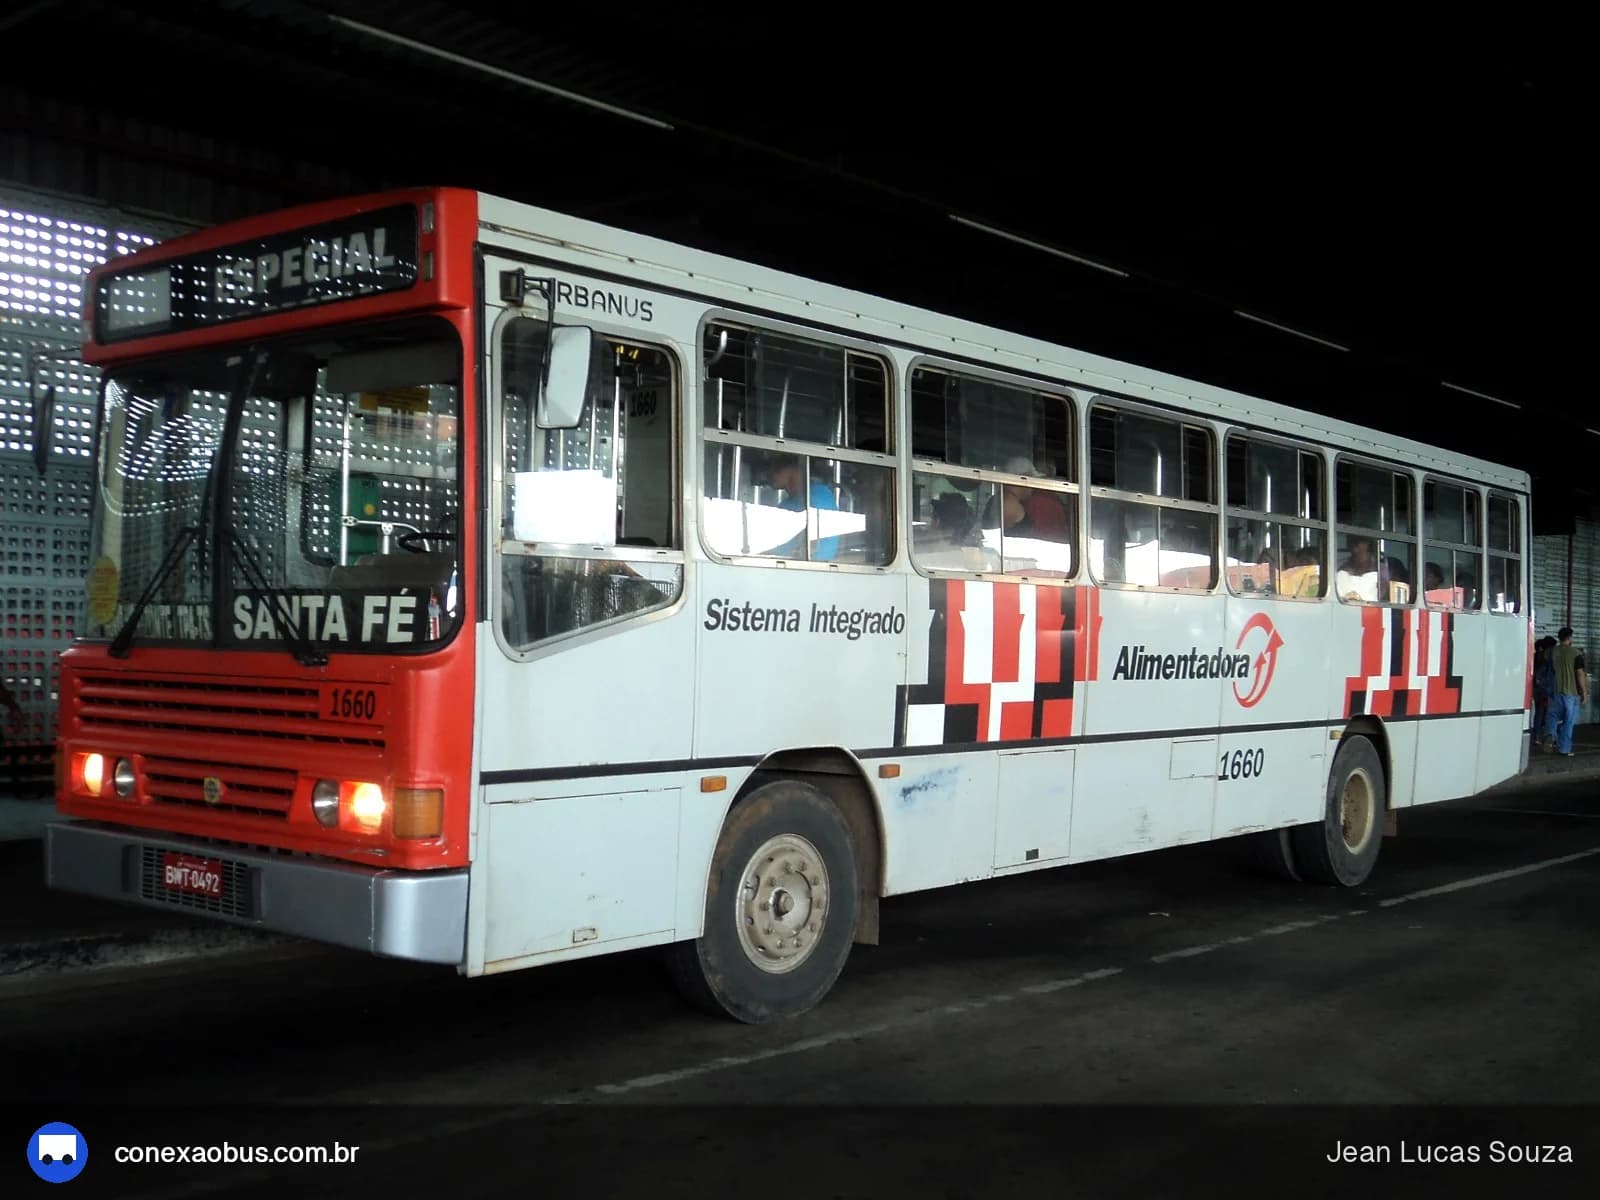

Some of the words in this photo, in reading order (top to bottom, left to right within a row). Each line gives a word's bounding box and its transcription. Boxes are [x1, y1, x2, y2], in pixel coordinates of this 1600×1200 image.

[214, 228, 395, 300] ESPECIAL
[233, 594, 349, 642] SANTA
[361, 587, 417, 643] FÉ
[704, 598, 800, 632] Sistema
[809, 602, 906, 641] Integrado
[1112, 645, 1251, 681] Alimentadora
[331, 687, 377, 720] 1660
[1217, 747, 1265, 781] 1660
